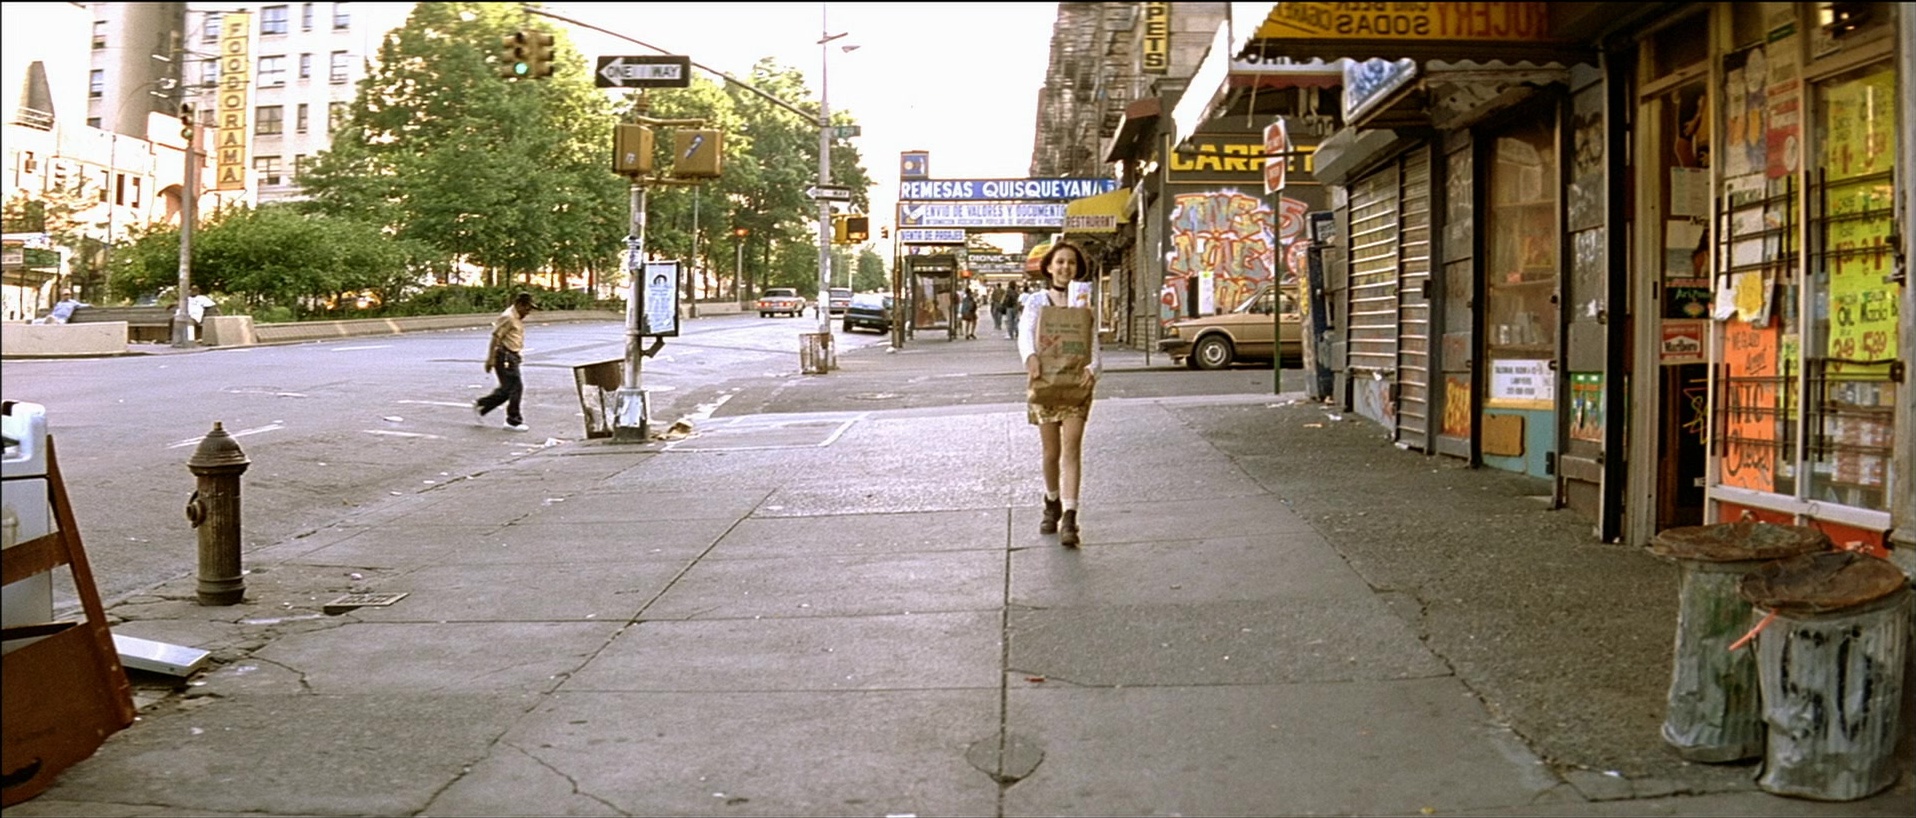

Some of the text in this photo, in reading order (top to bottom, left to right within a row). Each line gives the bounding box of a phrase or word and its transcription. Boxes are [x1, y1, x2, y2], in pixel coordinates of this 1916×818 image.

[1145, 3, 1165, 67] PETS
[606, 66, 679, 78] ONE WAY
[222, 22, 242, 183] FOODORAMA
[901, 179, 1103, 199] REMESAS QUISQUEYANA
[925, 205, 950, 217] ENVIO
[953, 205, 963, 217] DE
[967, 205, 1003, 217] VALORES
[1006, 205, 1013, 217] Y
[1065, 215, 1115, 228] RESTAURANT
[901, 230, 922, 240] VENTA
[924, 230, 933, 240] DE
[1664, 339, 1699, 352] Marlboro
